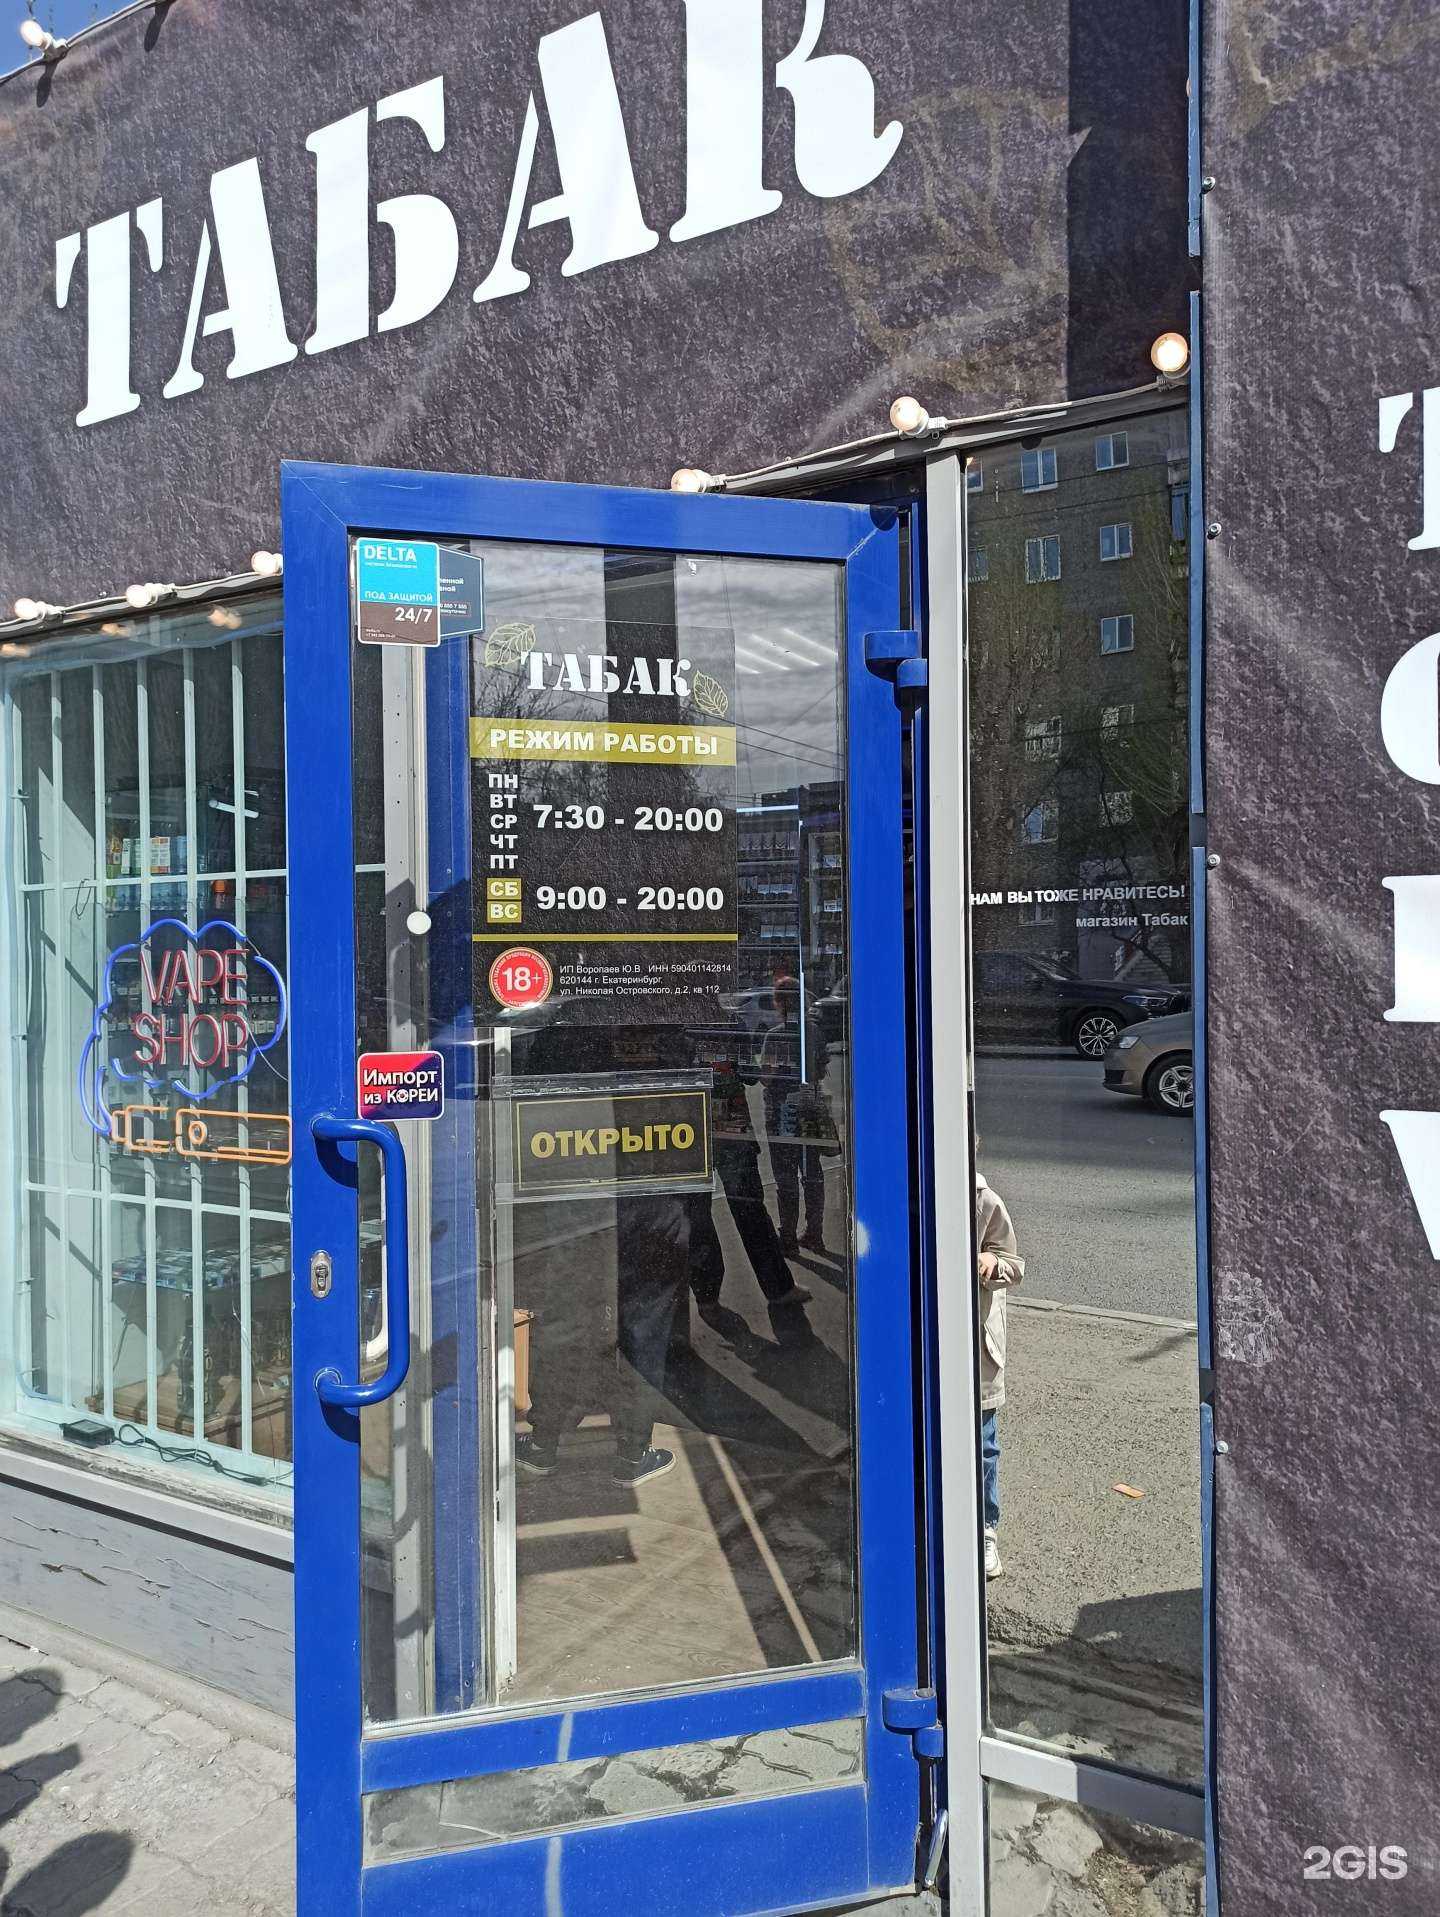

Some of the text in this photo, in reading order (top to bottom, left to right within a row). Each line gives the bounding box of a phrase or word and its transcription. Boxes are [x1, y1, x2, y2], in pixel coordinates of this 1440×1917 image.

[55, 0, 904, 428] ТАБАК
[364, 544, 417, 562] DELTA
[364, 590, 433, 603] ПОД ЗАЩИТОЙ
[394, 606, 433, 624] 24/7
[520, 651, 691, 697] ТАБАК
[490, 728, 717, 755] РЕЖИМ РАБОТЫ
[488, 773, 518, 788] ПН
[490, 794, 517, 809] ВТ
[490, 814, 517, 829] СР
[533, 804, 604, 829] 7:30
[634, 806, 724, 831] 20:00
[490, 834, 517, 849] ЧТ
[490, 854, 518, 869] ПТ
[490, 881, 519, 897] СБ
[970, 885, 1186, 905] НАМ ВЫ ТОЖЕ НРАВИТЕСЬ!
[536, 886, 606, 910] 9:00
[638, 887, 724, 910] 20:00
[490, 904, 519, 919] ВС
[1076, 912, 1189, 928] магазин Табак
[648, 965, 669, 973] ИНН
[139, 949, 249, 1006] VAPE
[502, 966, 542, 992] 18+
[560, 976, 592, 984] 620144
[576, 986, 614, 995] Николая
[705, 984, 719, 993] 112
[134, 1012, 249, 1068] SHOP
[363, 1069, 438, 1086] Импорт
[364, 1088, 439, 1104] из КОРЕИ
[530, 1122, 695, 1159] ОТКРЫТО
